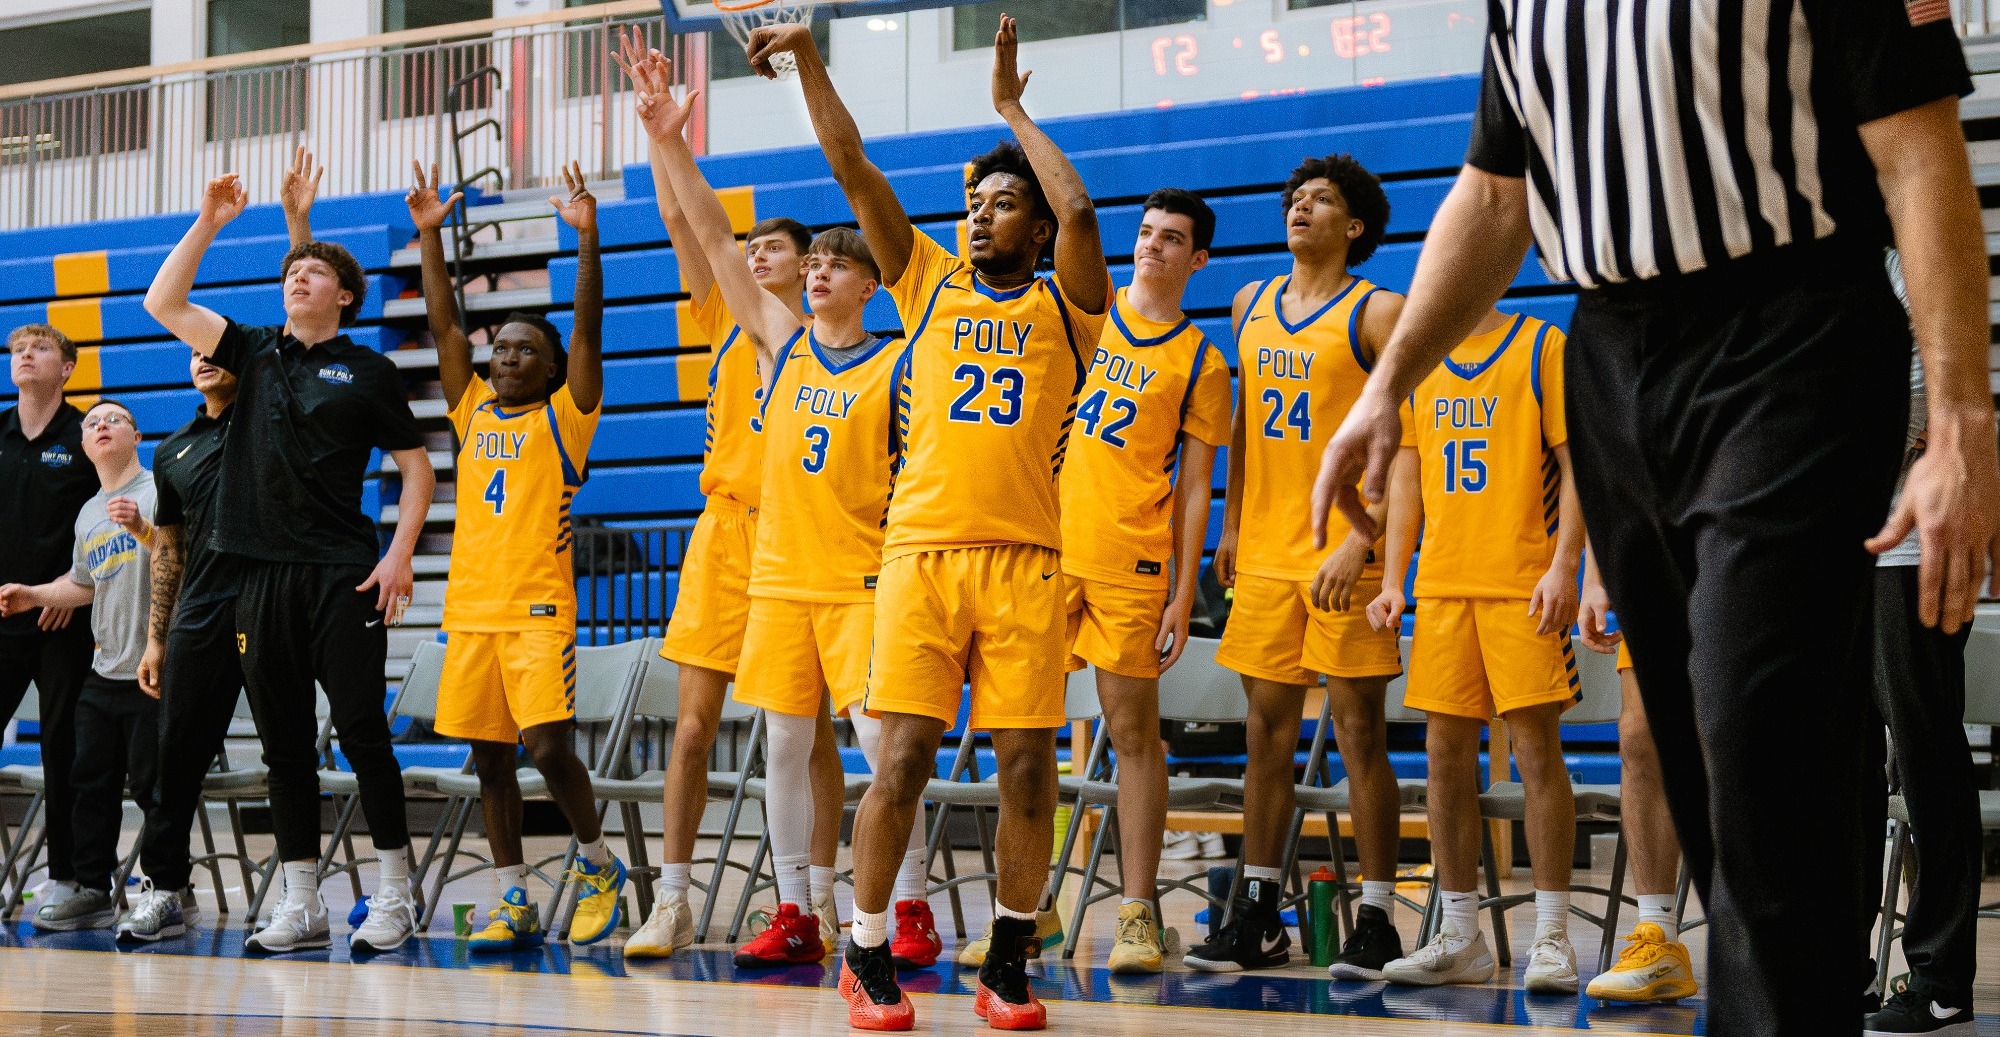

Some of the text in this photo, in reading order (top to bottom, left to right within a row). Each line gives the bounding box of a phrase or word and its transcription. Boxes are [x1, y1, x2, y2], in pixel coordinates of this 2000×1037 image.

[952, 316, 1034, 357] POLY
[1087, 346, 1158, 393] POLY
[1257, 346, 1316, 381] POLY
[793, 384, 859, 420] POLY
[948, 362, 1026, 427] 23
[1075, 387, 1138, 449] 42
[1261, 387, 1312, 442] 24
[1435, 395, 1499, 430] POLY
[474, 431, 528, 459] POLY
[802, 423, 831, 475] 3
[1442, 438, 1488, 493] 15
[483, 468, 506, 515] 4
